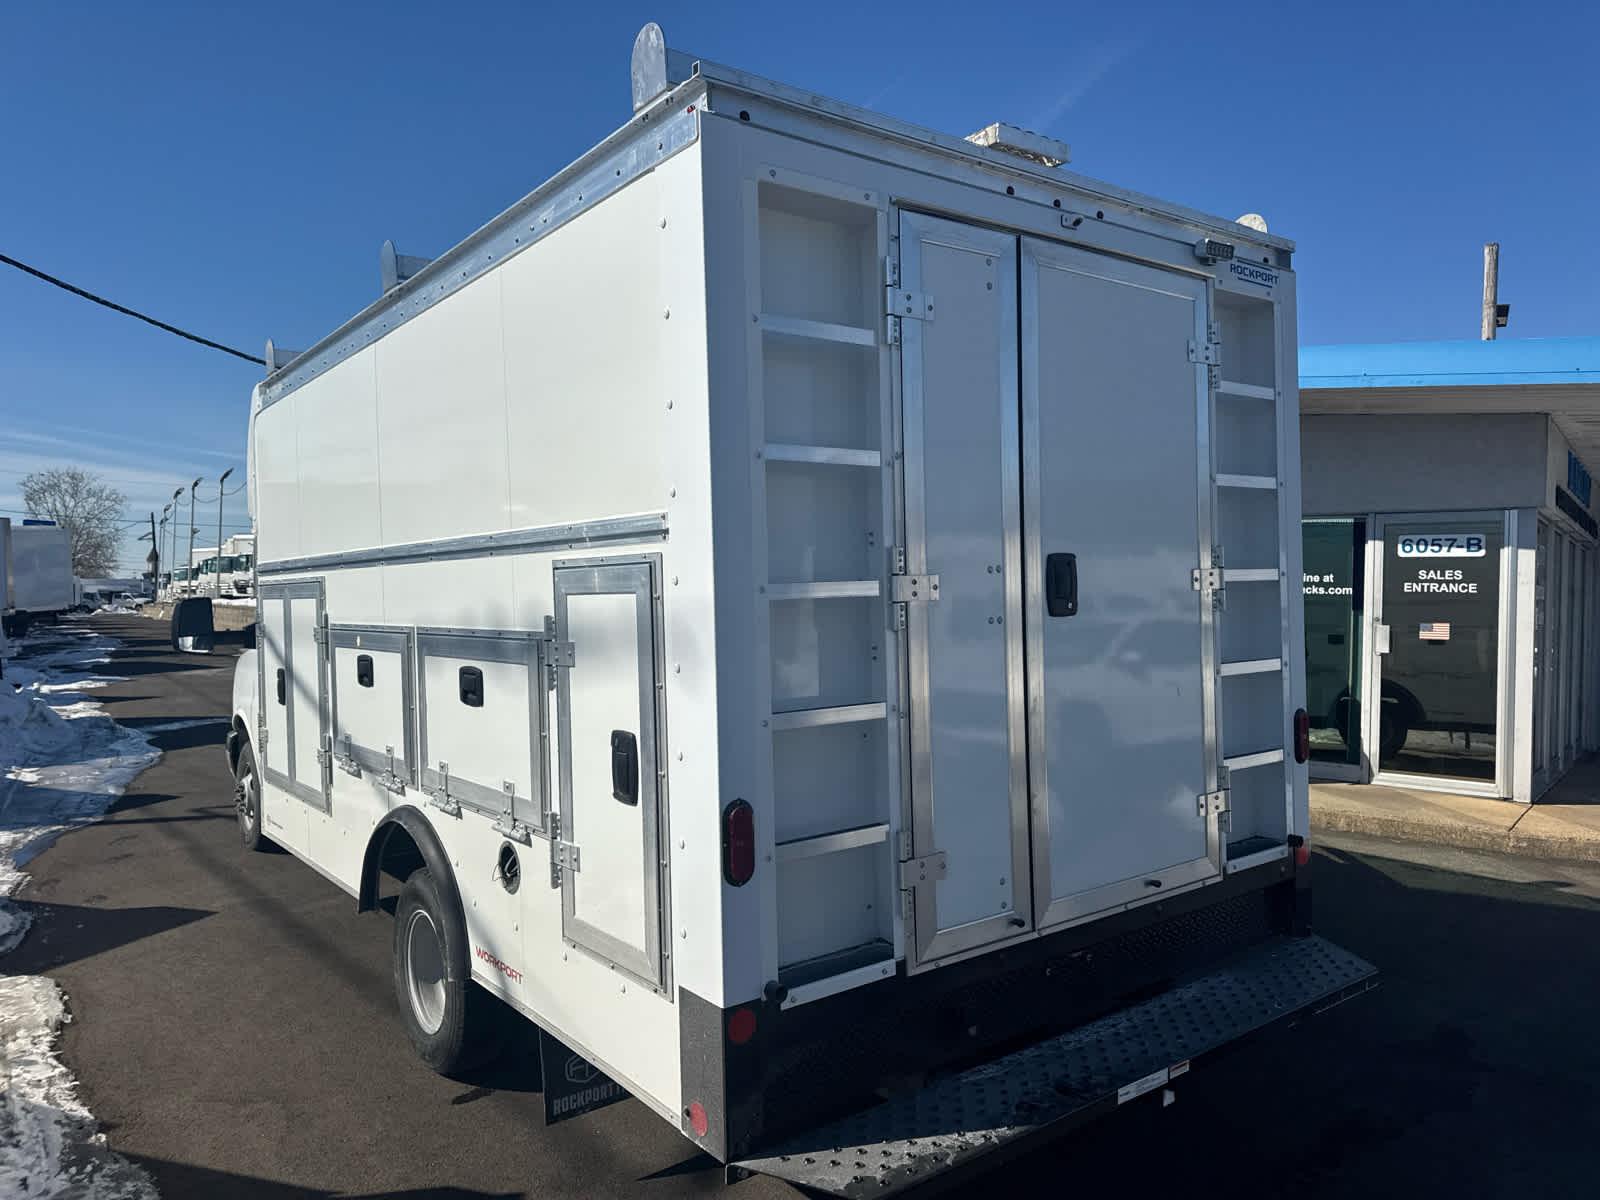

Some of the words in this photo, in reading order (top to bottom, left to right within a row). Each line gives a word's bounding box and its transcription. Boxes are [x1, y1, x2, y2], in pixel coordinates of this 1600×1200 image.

[1230, 263, 1279, 285] ROCKPORT
[1402, 537, 1482, 553] 6057-B
[1323, 573, 1334, 583] at
[1418, 570, 1463, 580] SALES
[1403, 582, 1478, 593] ENTRANCE
[475, 945, 523, 985] WORKPORT
[552, 1083, 615, 1117] ROCKPORT
